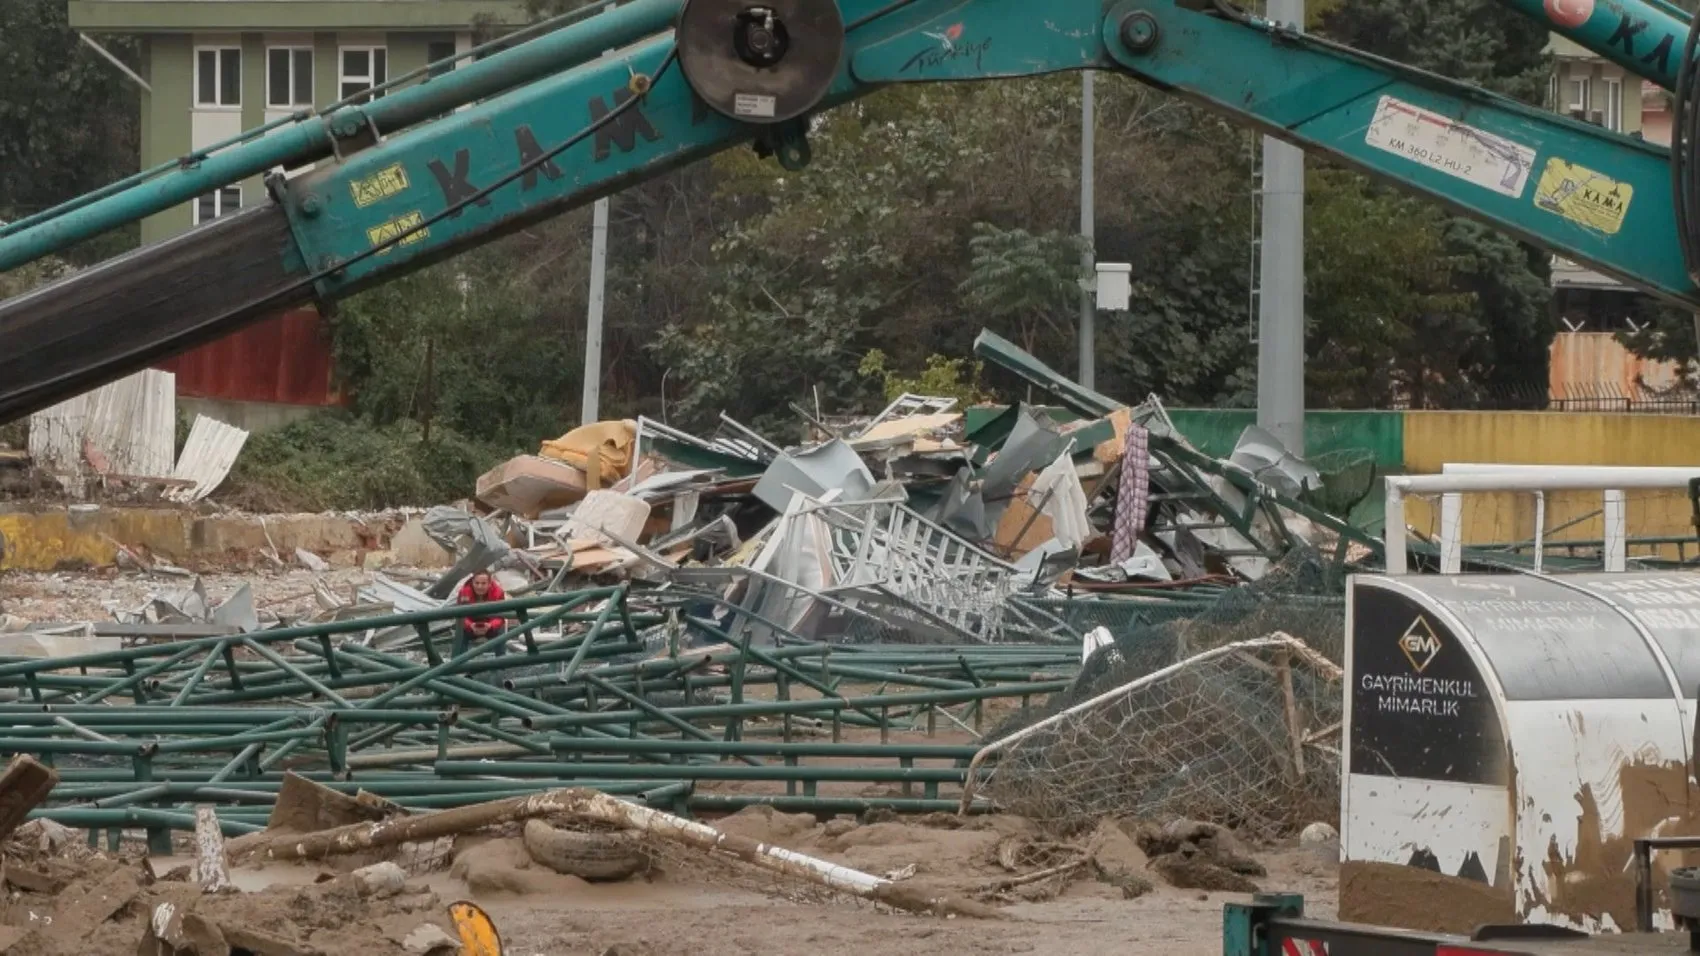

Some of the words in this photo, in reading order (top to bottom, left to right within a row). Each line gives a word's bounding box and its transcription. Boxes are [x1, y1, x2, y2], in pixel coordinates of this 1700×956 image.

[1607, 4, 1675, 73] KA
[427, 84, 704, 218] KAM
[1388, 138, 1405, 152] KM
[1407, 144, 1428, 159] 360
[1429, 152, 1443, 164] L2
[1444, 158, 1473, 177] HU-2
[1583, 188, 1623, 213] KAMA
[1404, 634, 1437, 656] GM
[1361, 672, 1478, 698] GAYRİMENKUL
[1378, 690, 1459, 717] MİMARLIK
